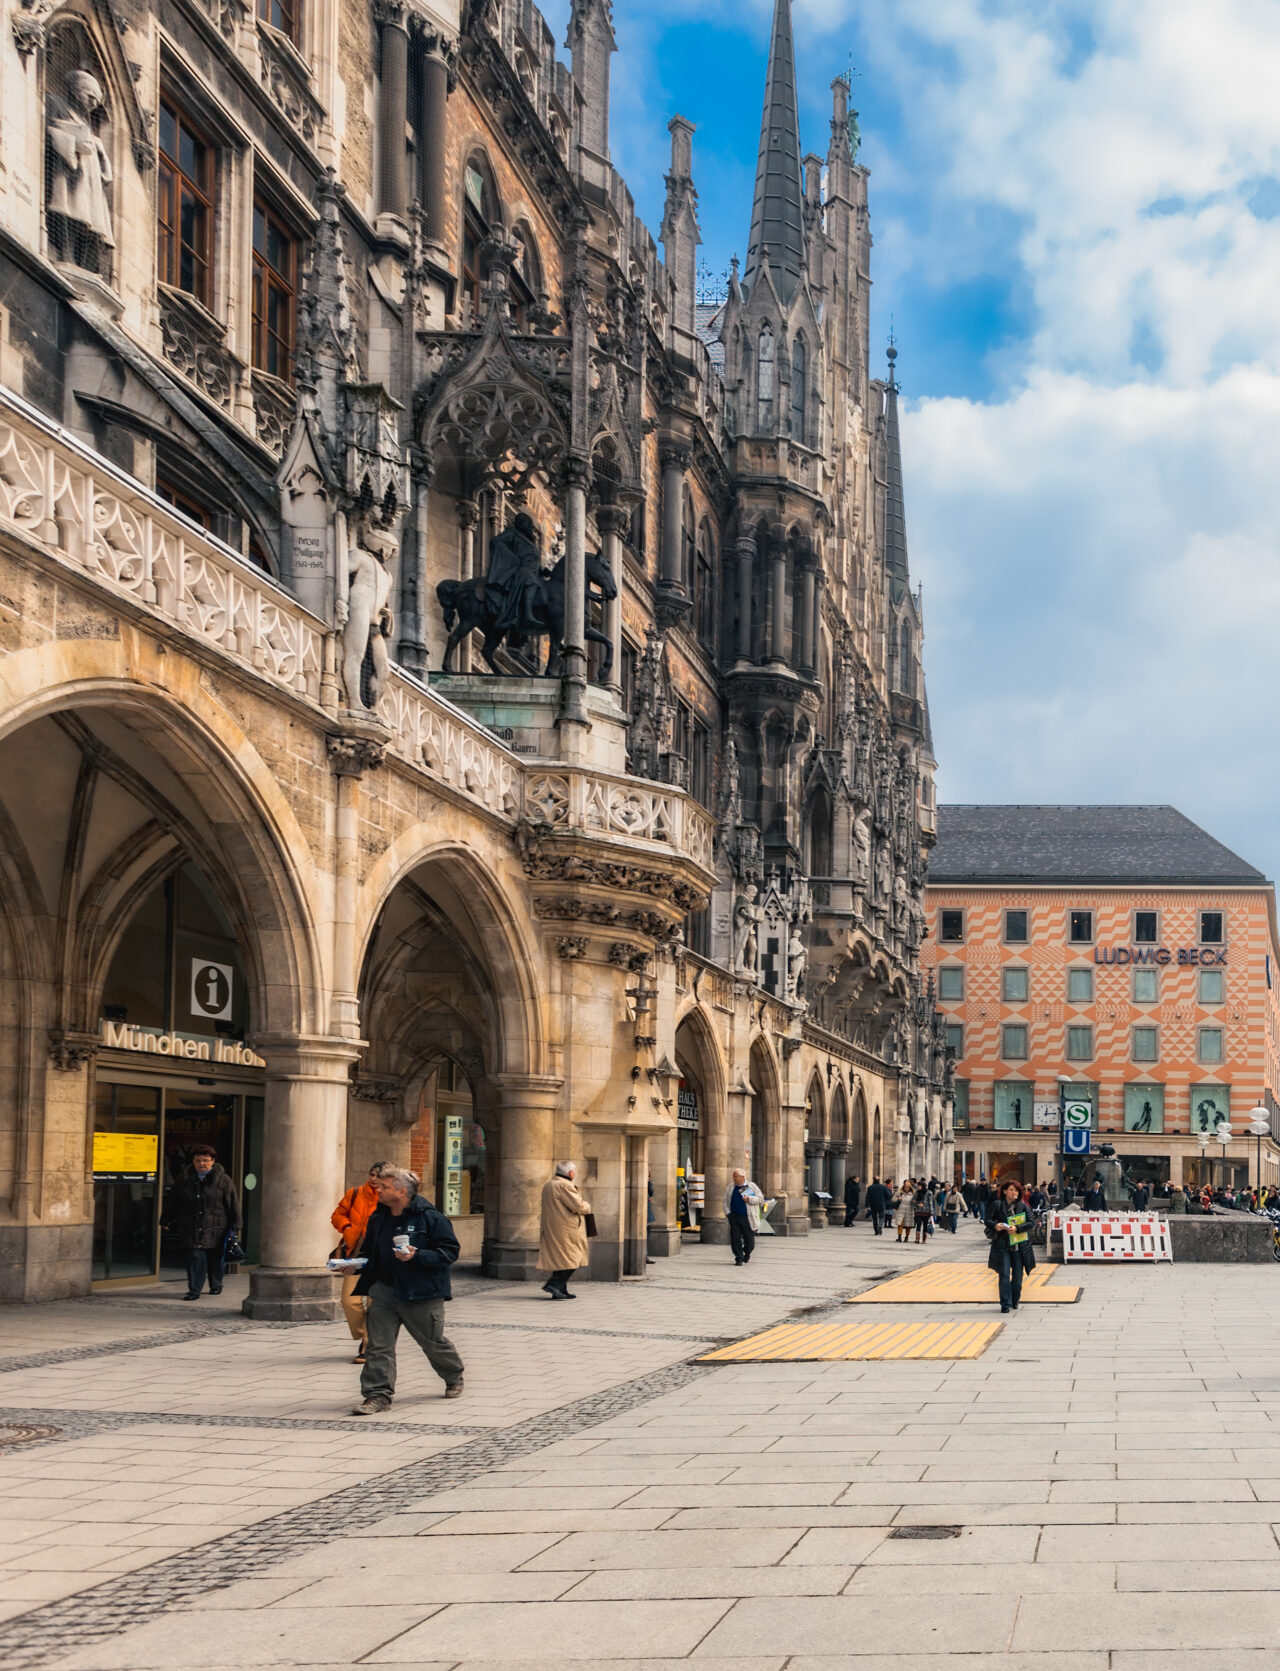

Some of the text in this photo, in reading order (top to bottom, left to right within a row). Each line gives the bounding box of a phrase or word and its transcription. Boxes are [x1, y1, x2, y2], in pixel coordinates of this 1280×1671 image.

[1095, 947, 1228, 965] LUDWIG BECK
[106, 1021, 266, 1068] München Info
[679, 1091, 695, 1106] HAUS
[1069, 1104, 1087, 1125] S
[1068, 1131, 1087, 1152] U
